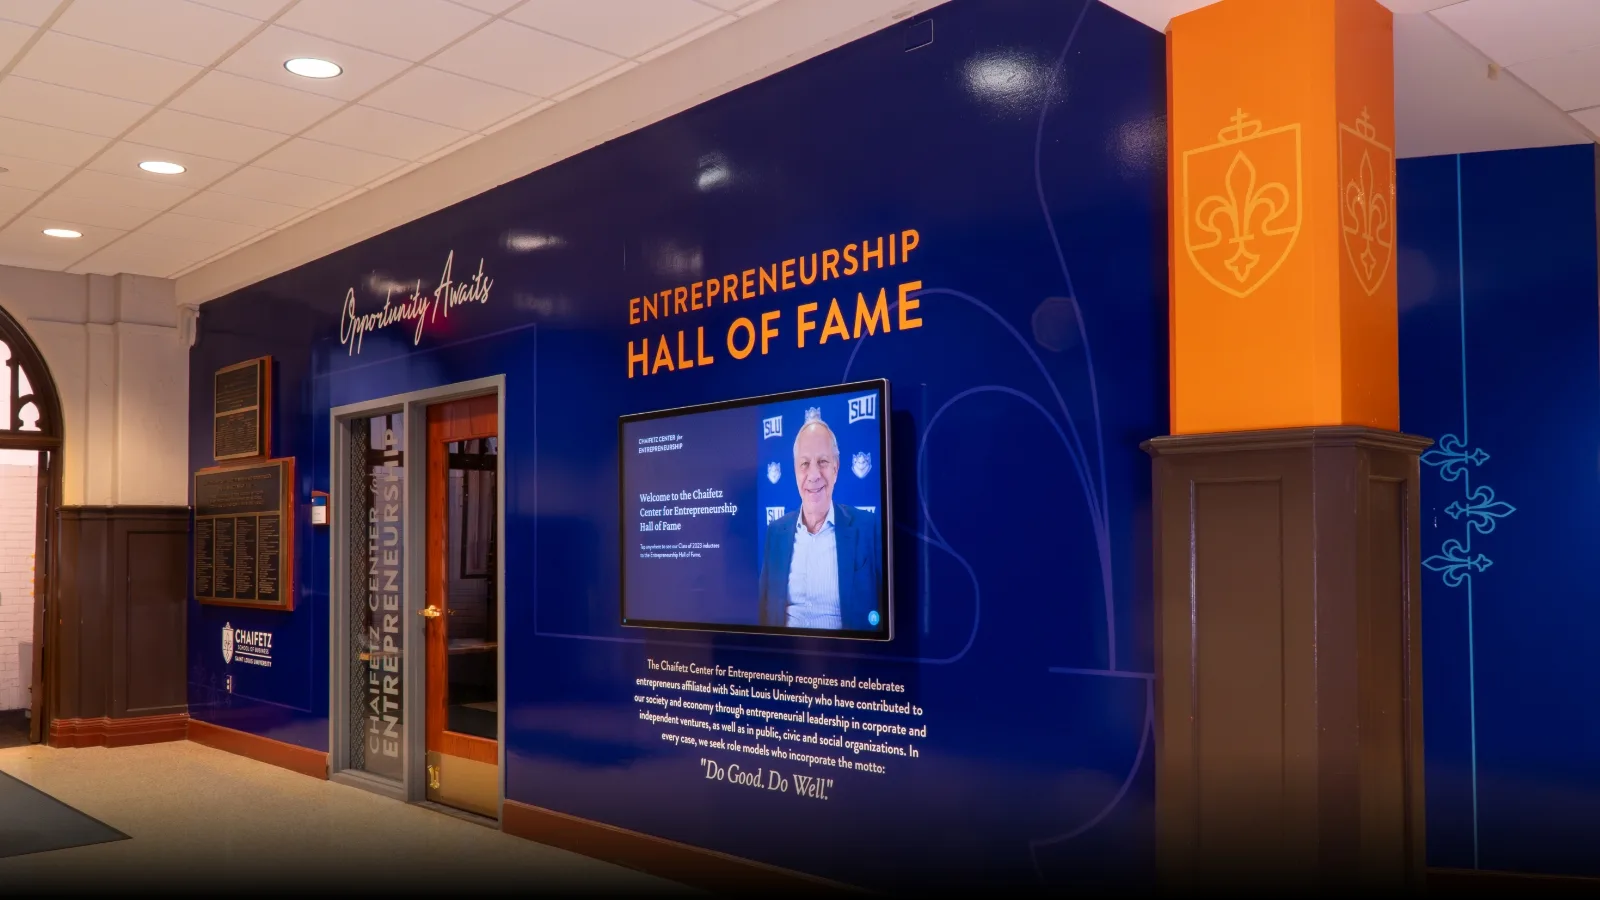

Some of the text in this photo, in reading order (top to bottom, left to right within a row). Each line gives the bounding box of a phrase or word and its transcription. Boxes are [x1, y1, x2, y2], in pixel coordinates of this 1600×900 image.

[629, 229, 920, 324] ENTREPRENEURSHIP
[340, 250, 494, 356] Opportunity Awaits
[627, 280, 923, 378] HALL OF FAME
[849, 395, 876, 420] SLU
[638, 436, 658, 444] CHAIFETZ
[764, 418, 781, 437] SLU
[638, 443, 683, 454] ENTREPRENEURSHIP
[640, 488, 723, 502] Welcome to the Chaifetz
[640, 502, 737, 517] Center for Entrepreneurship
[640, 521, 681, 531] Hall of Fame
[369, 468, 380, 754] CHAIFETZ CENTER for
[383, 428, 399, 758] ENTREPRENEURSHIP
[235, 629, 272, 648] CHAIFETZ
[254, 659, 272, 667] UNIVERSITY
[647, 658, 905, 692] The Chaifetz Center for Entrepreneurship recognizes and celebrates
[636, 678, 923, 716] entrepreneurs affiliated with Saint Louis University who have contributed to
[646, 694, 668, 708] society
[670, 697, 682, 707] and
[683, 700, 714, 715] economy
[716, 702, 744, 719] through
[746, 708, 805, 723] entrepreneurial
[807, 711, 850, 732] leadership
[852, 717, 860, 729] in
[862, 722, 906, 736] corporate
[909, 725, 926, 737] and
[639, 710, 679, 724] independent
[680, 718, 711, 731] ventures,
[722, 722, 735, 732] well
[737, 726, 745, 734] as
[746, 724, 754, 735] in
[756, 726, 781, 741] public,
[783, 729, 801, 741] civic
[802, 733, 817, 744] and
[820, 735, 843, 747] social
[845, 740, 906, 756] organizations.
[910, 744, 919, 758] In
[662, 733, 885, 773] every case, we seek role models who incorporate the motto:
[701, 758, 833, 800] "Do Good. Do Well."
